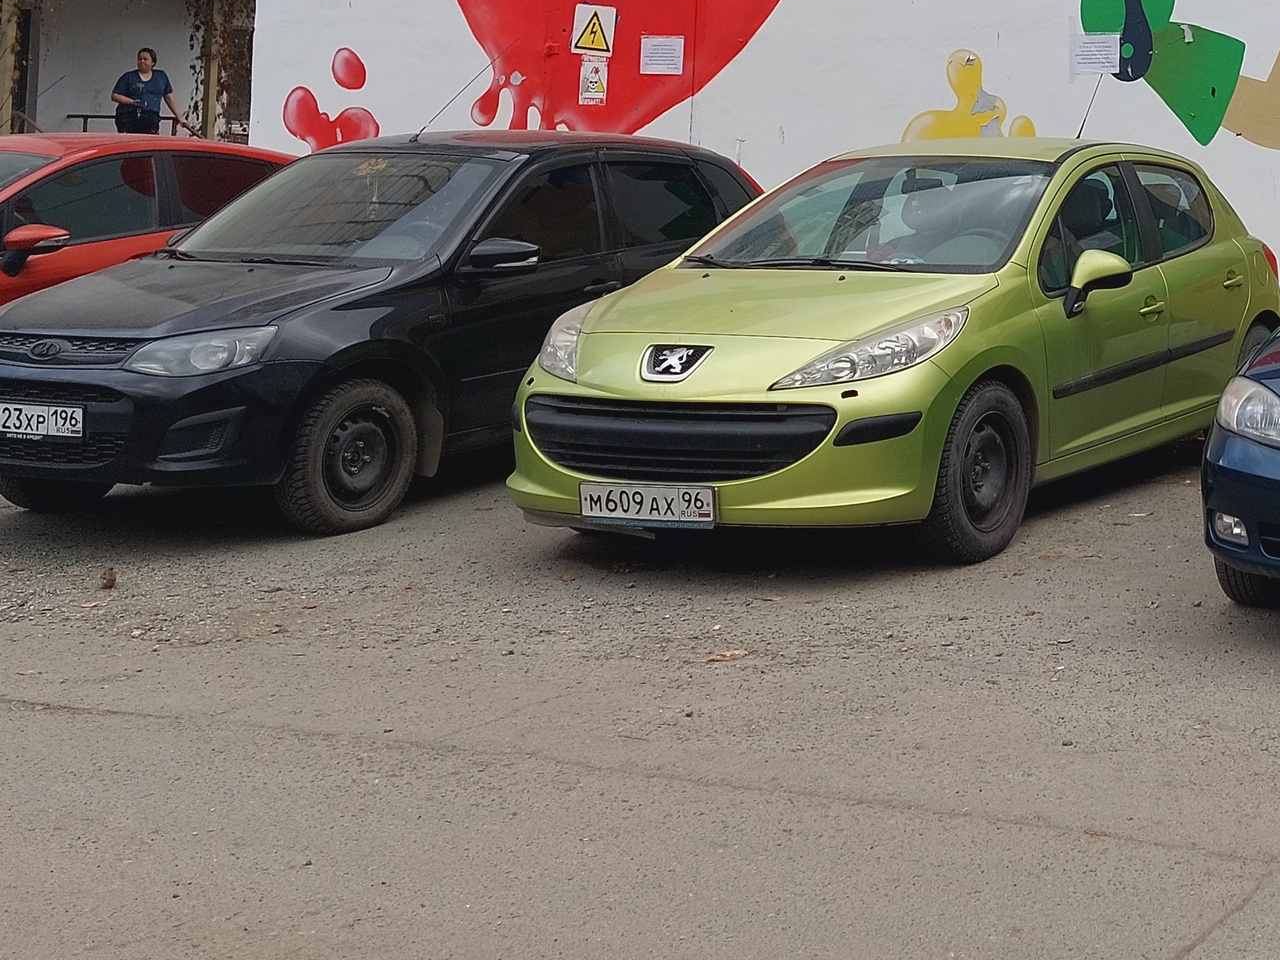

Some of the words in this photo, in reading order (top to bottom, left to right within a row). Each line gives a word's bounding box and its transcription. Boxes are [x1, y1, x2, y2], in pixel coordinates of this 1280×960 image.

[50, 408, 78, 428] 196
[681, 491, 705, 510] 96
[681, 510, 698, 518] RUS
